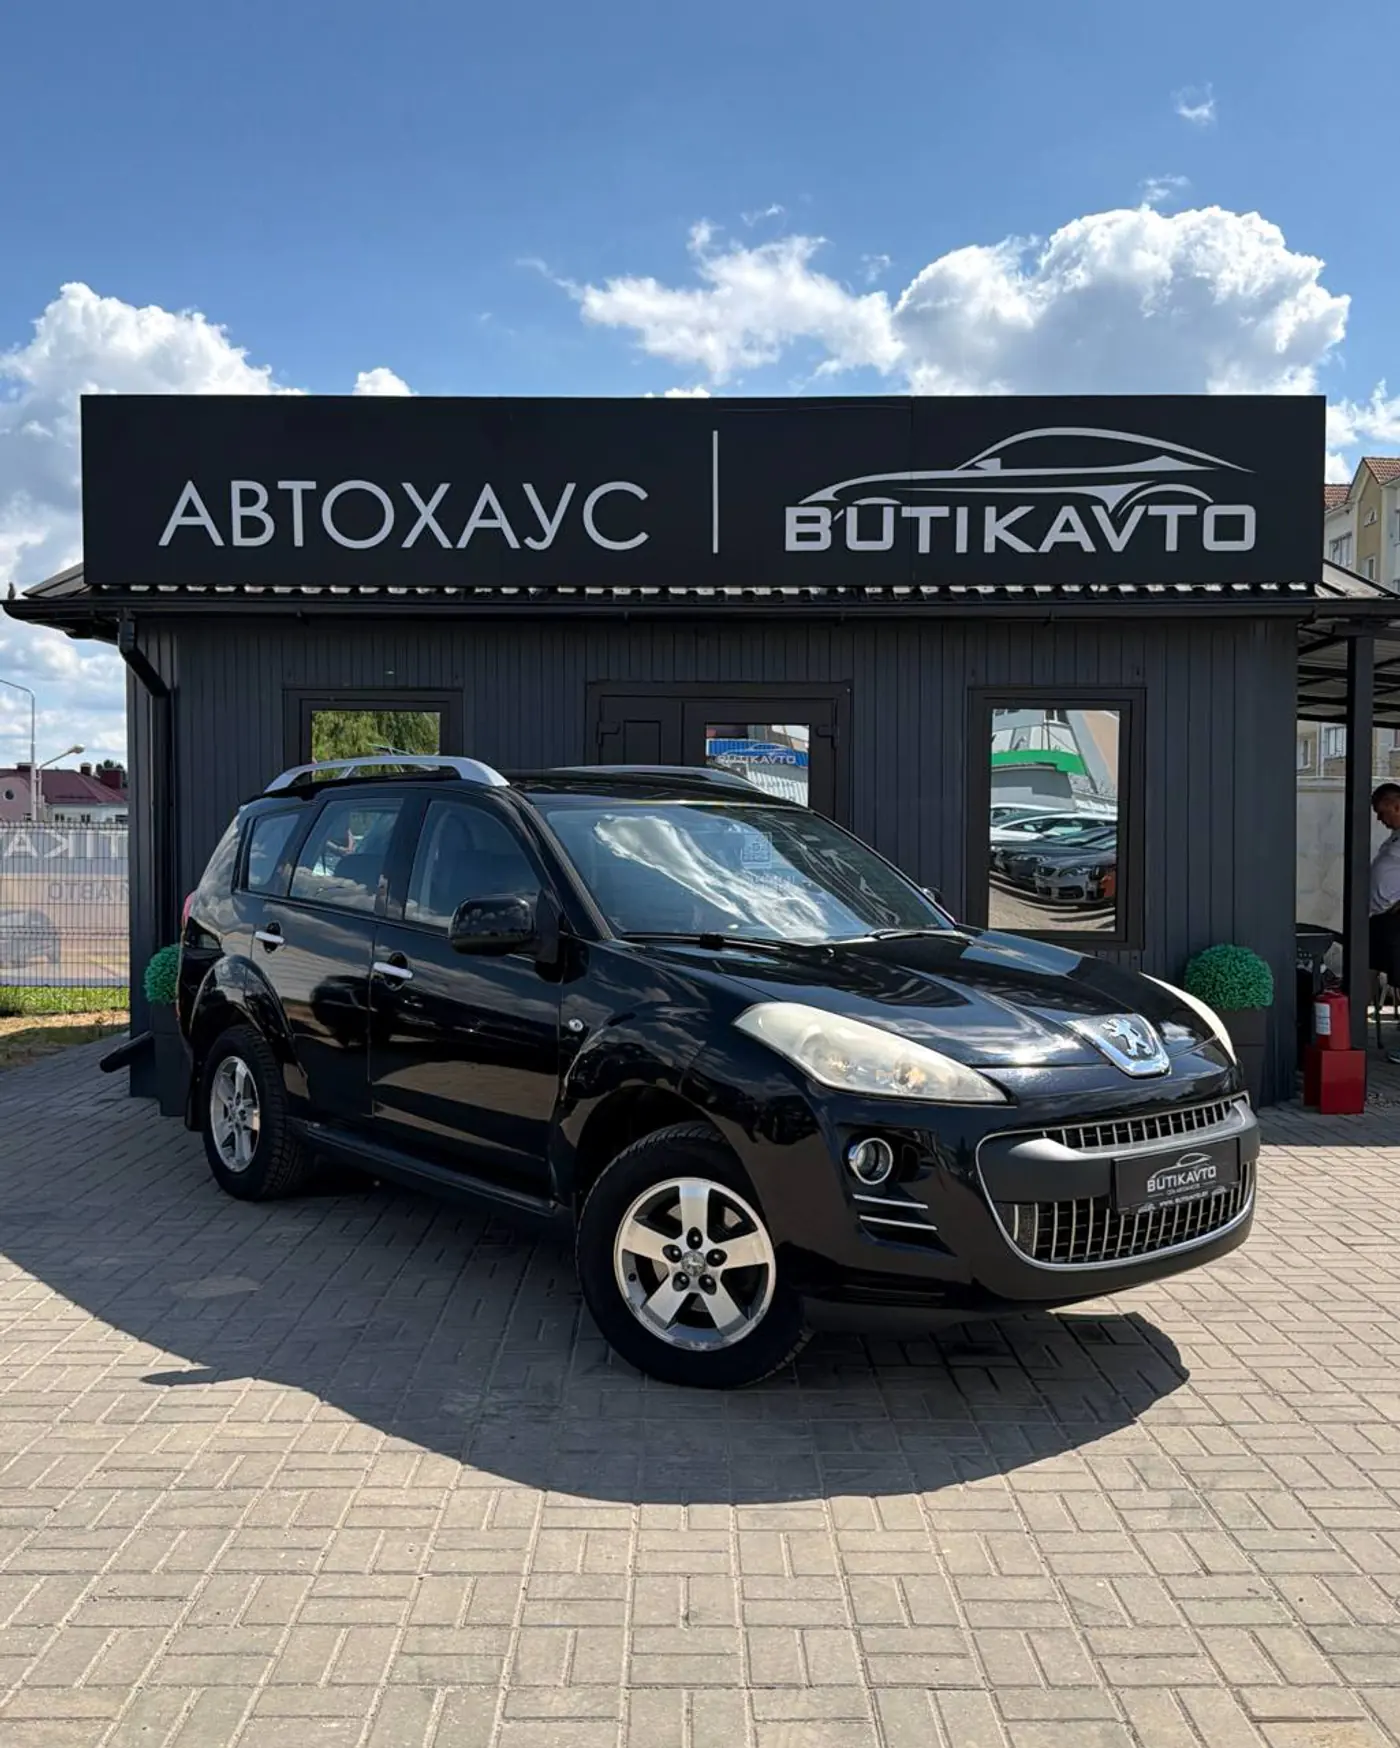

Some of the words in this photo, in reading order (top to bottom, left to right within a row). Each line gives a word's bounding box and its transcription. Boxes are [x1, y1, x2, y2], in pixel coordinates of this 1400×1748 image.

[158, 480, 650, 551] АВТОХАУС
[785, 504, 1256, 554] BUTIKAVTO
[1147, 1165, 1217, 1193] BUTIKAVTO
